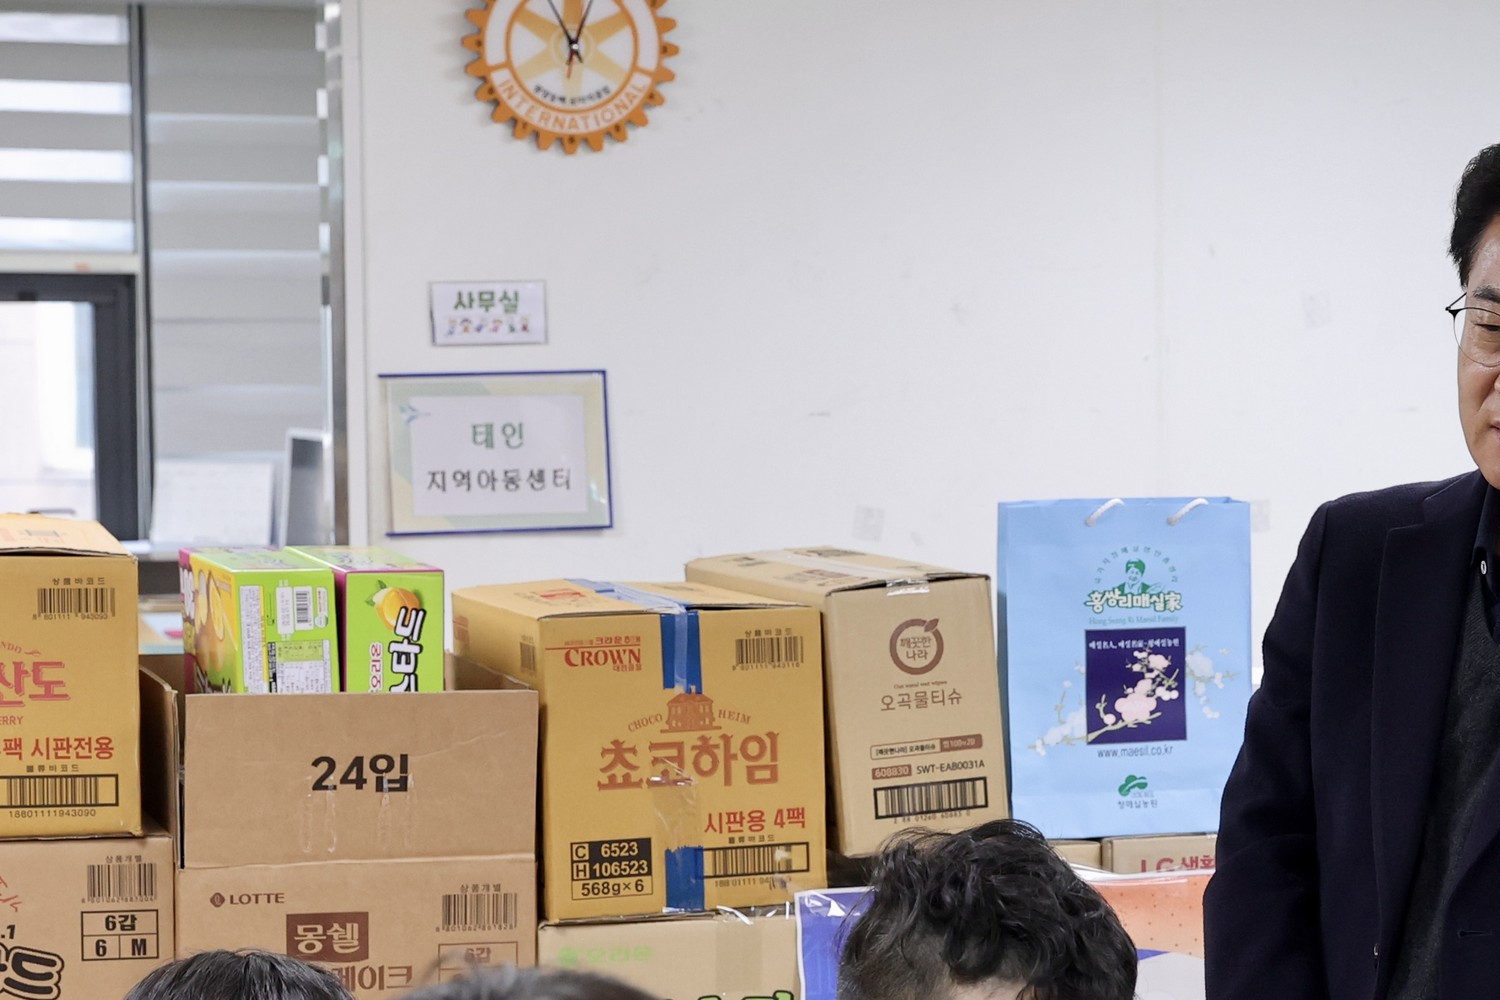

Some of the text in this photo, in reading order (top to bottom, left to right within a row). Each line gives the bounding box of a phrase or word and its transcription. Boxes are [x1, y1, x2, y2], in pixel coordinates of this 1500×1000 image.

[498, 80, 646, 131] INTERNATIONAL
[453, 290, 520, 313] 사무실
[471, 422, 525, 451] 태인
[426, 467, 571, 493] 지역아동센터
[900, 635, 932, 649] 깨끗한
[564, 647, 641, 668] CROWN
[906, 648, 929, 661] 나라
[370, 642, 383, 689] 오리온
[880, 687, 963, 712] 오곡물티슈
[627, 708, 752, 733] CHOCO HEIM
[31, 736, 115, 760] 시판전용
[1097, 744, 1174, 758] www.maesil.co.kr
[310, 753, 409, 793] 24입
[874, 759, 986, 779] 608830 SWT-EAB0031A
[9, 808, 97, 819] 18801111943090
[704, 806, 807, 834] 시판용 4팩
[575, 842, 639, 860] C 6523
[575, 860, 649, 879] H 106523
[460, 883, 502, 894] 상품개별
[634, 878, 645, 894] 6
[228, 892, 285, 906] LOTTE
[105, 914, 138, 932] 6갑
[95, 938, 148, 958] 6 M
[293, 922, 362, 955] 몽쉘
